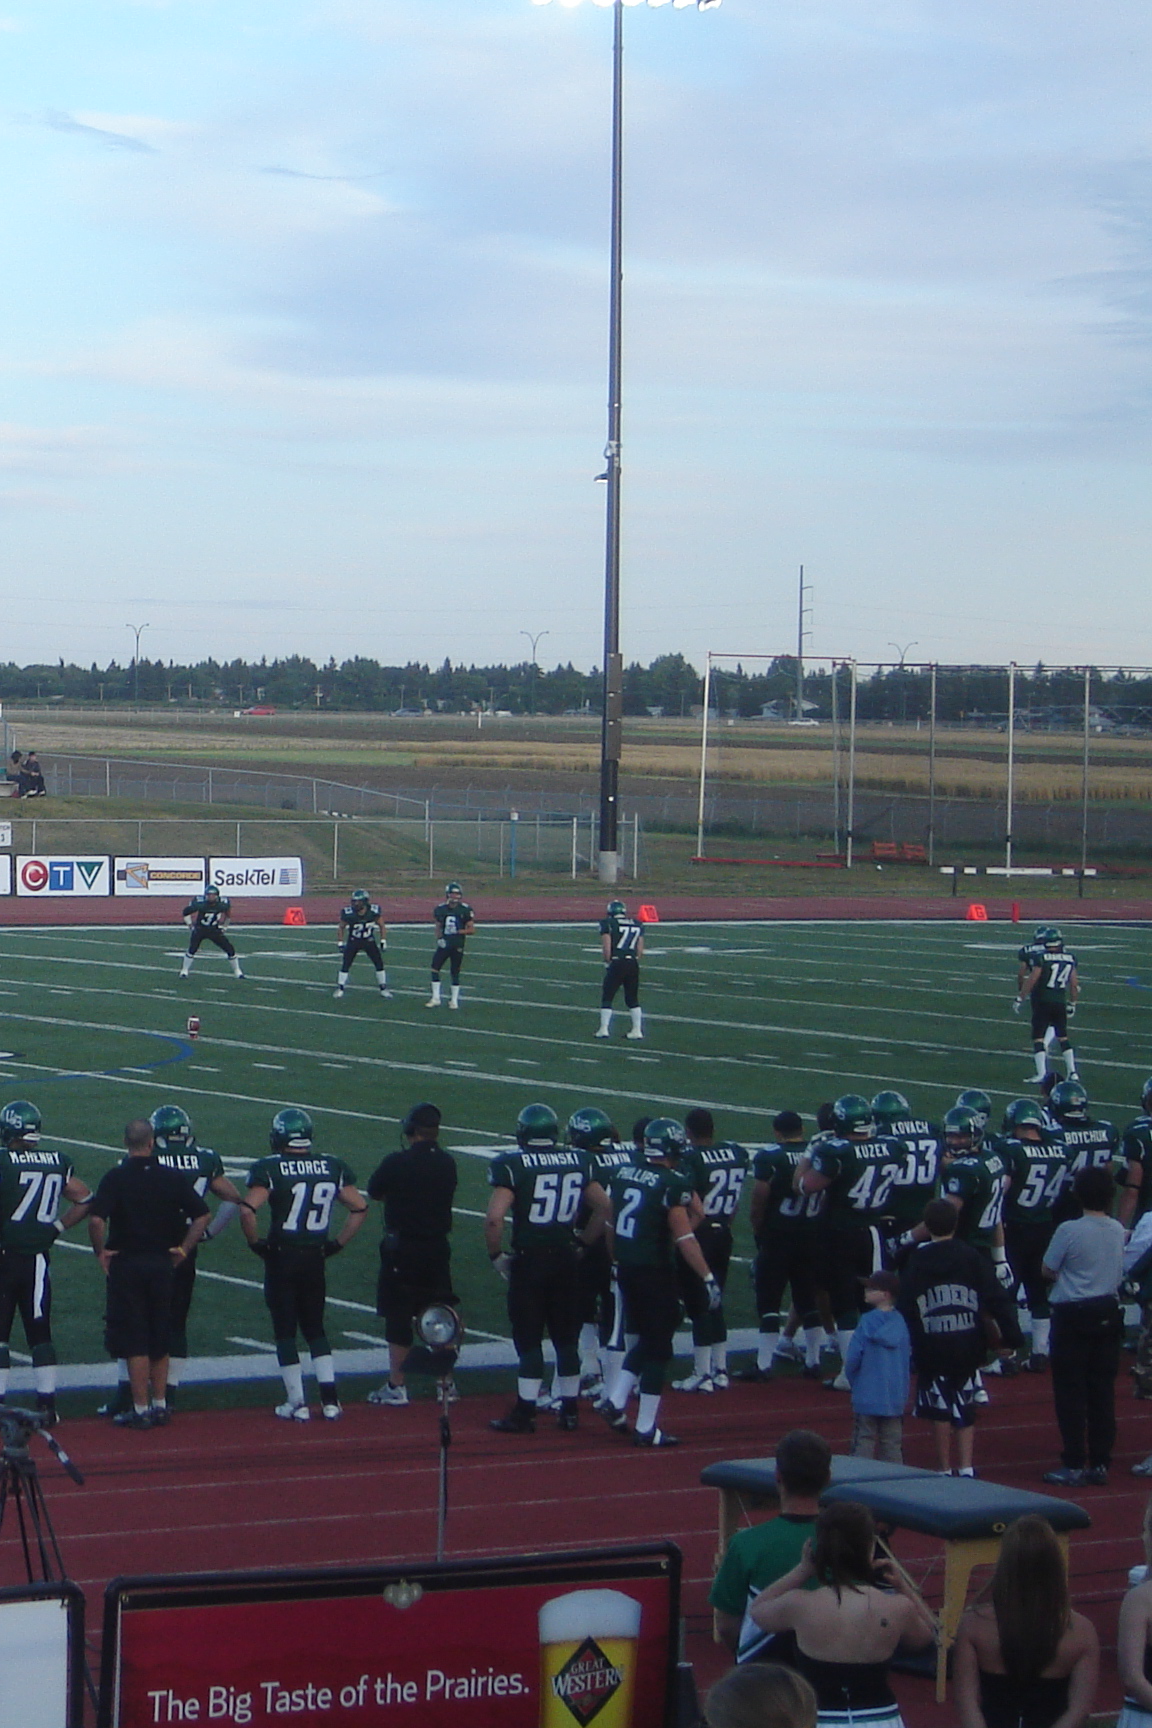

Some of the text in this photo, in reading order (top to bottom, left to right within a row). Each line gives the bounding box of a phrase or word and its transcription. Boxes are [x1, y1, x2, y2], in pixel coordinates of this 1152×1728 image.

[23, 865, 102, 887] CTV
[214, 869, 276, 886] SaskTel
[617, 926, 641, 949] 77
[1047, 963, 1073, 989] 14
[891, 1120, 929, 1136] KOVACH
[1064, 1129, 1109, 1145] BOYCHUK
[521, 1152, 579, 1168] RYBINSKI
[700, 1148, 736, 1165] ALLEN
[1022, 1145, 1067, 1160] WALLACE
[279, 1160, 331, 1176] GEORGE
[617, 1166, 660, 1188] PHILLIPS
[10, 1171, 63, 1223] 70
[528, 1172, 584, 1223] 56
[703, 1167, 746, 1216] 25
[847, 1163, 899, 1210] 42
[1017, 1163, 1067, 1210] 54
[282, 1181, 337, 1232] 19
[615, 1187, 642, 1239] 2
[916, 1284, 980, 1317] RAIDERS
[922, 1311, 977, 1334] FOOTBALL
[571, 1658, 605, 1675] GREAT
[551, 1665, 623, 1697] WESTERN
[147, 1667, 530, 1723] The Big Taste of the Prairies.
